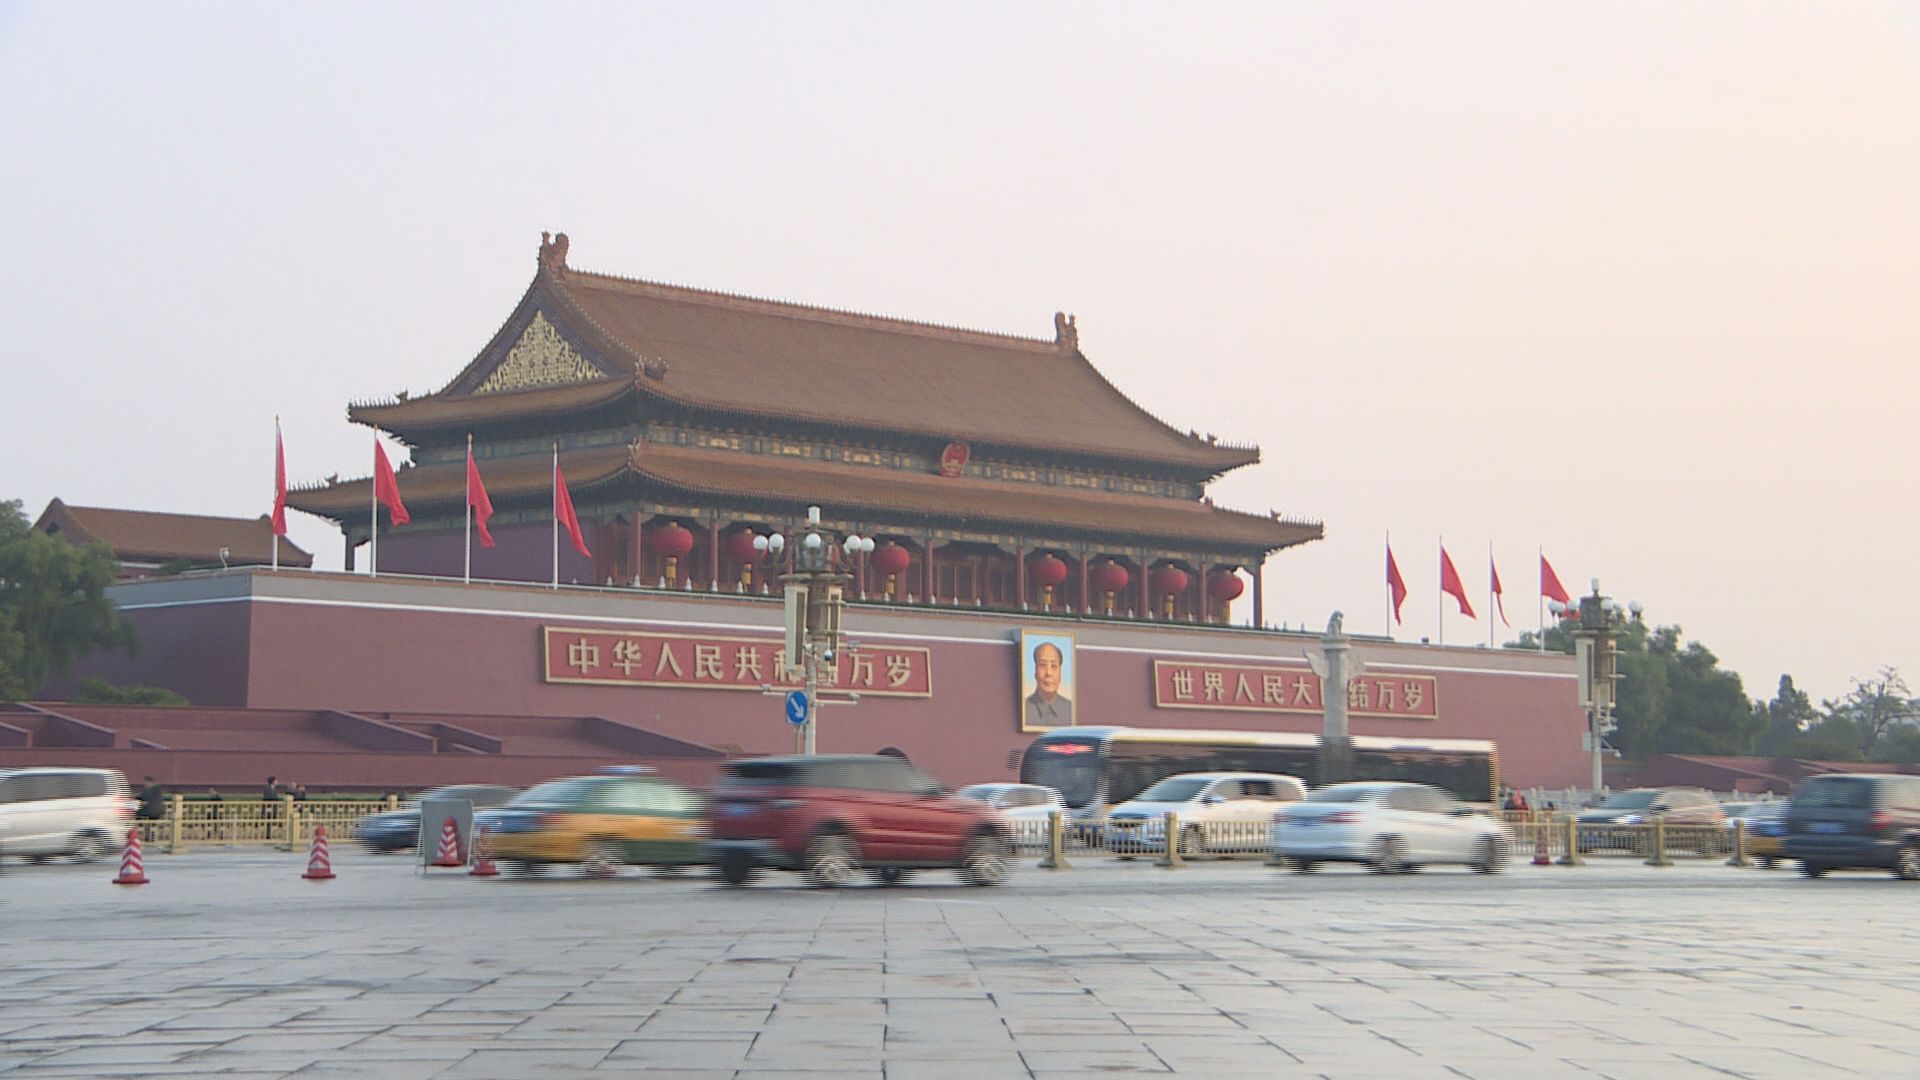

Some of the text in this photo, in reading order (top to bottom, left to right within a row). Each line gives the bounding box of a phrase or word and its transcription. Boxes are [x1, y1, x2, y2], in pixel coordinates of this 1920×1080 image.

[1173, 669, 1423, 710] 世界人民大结万岁
